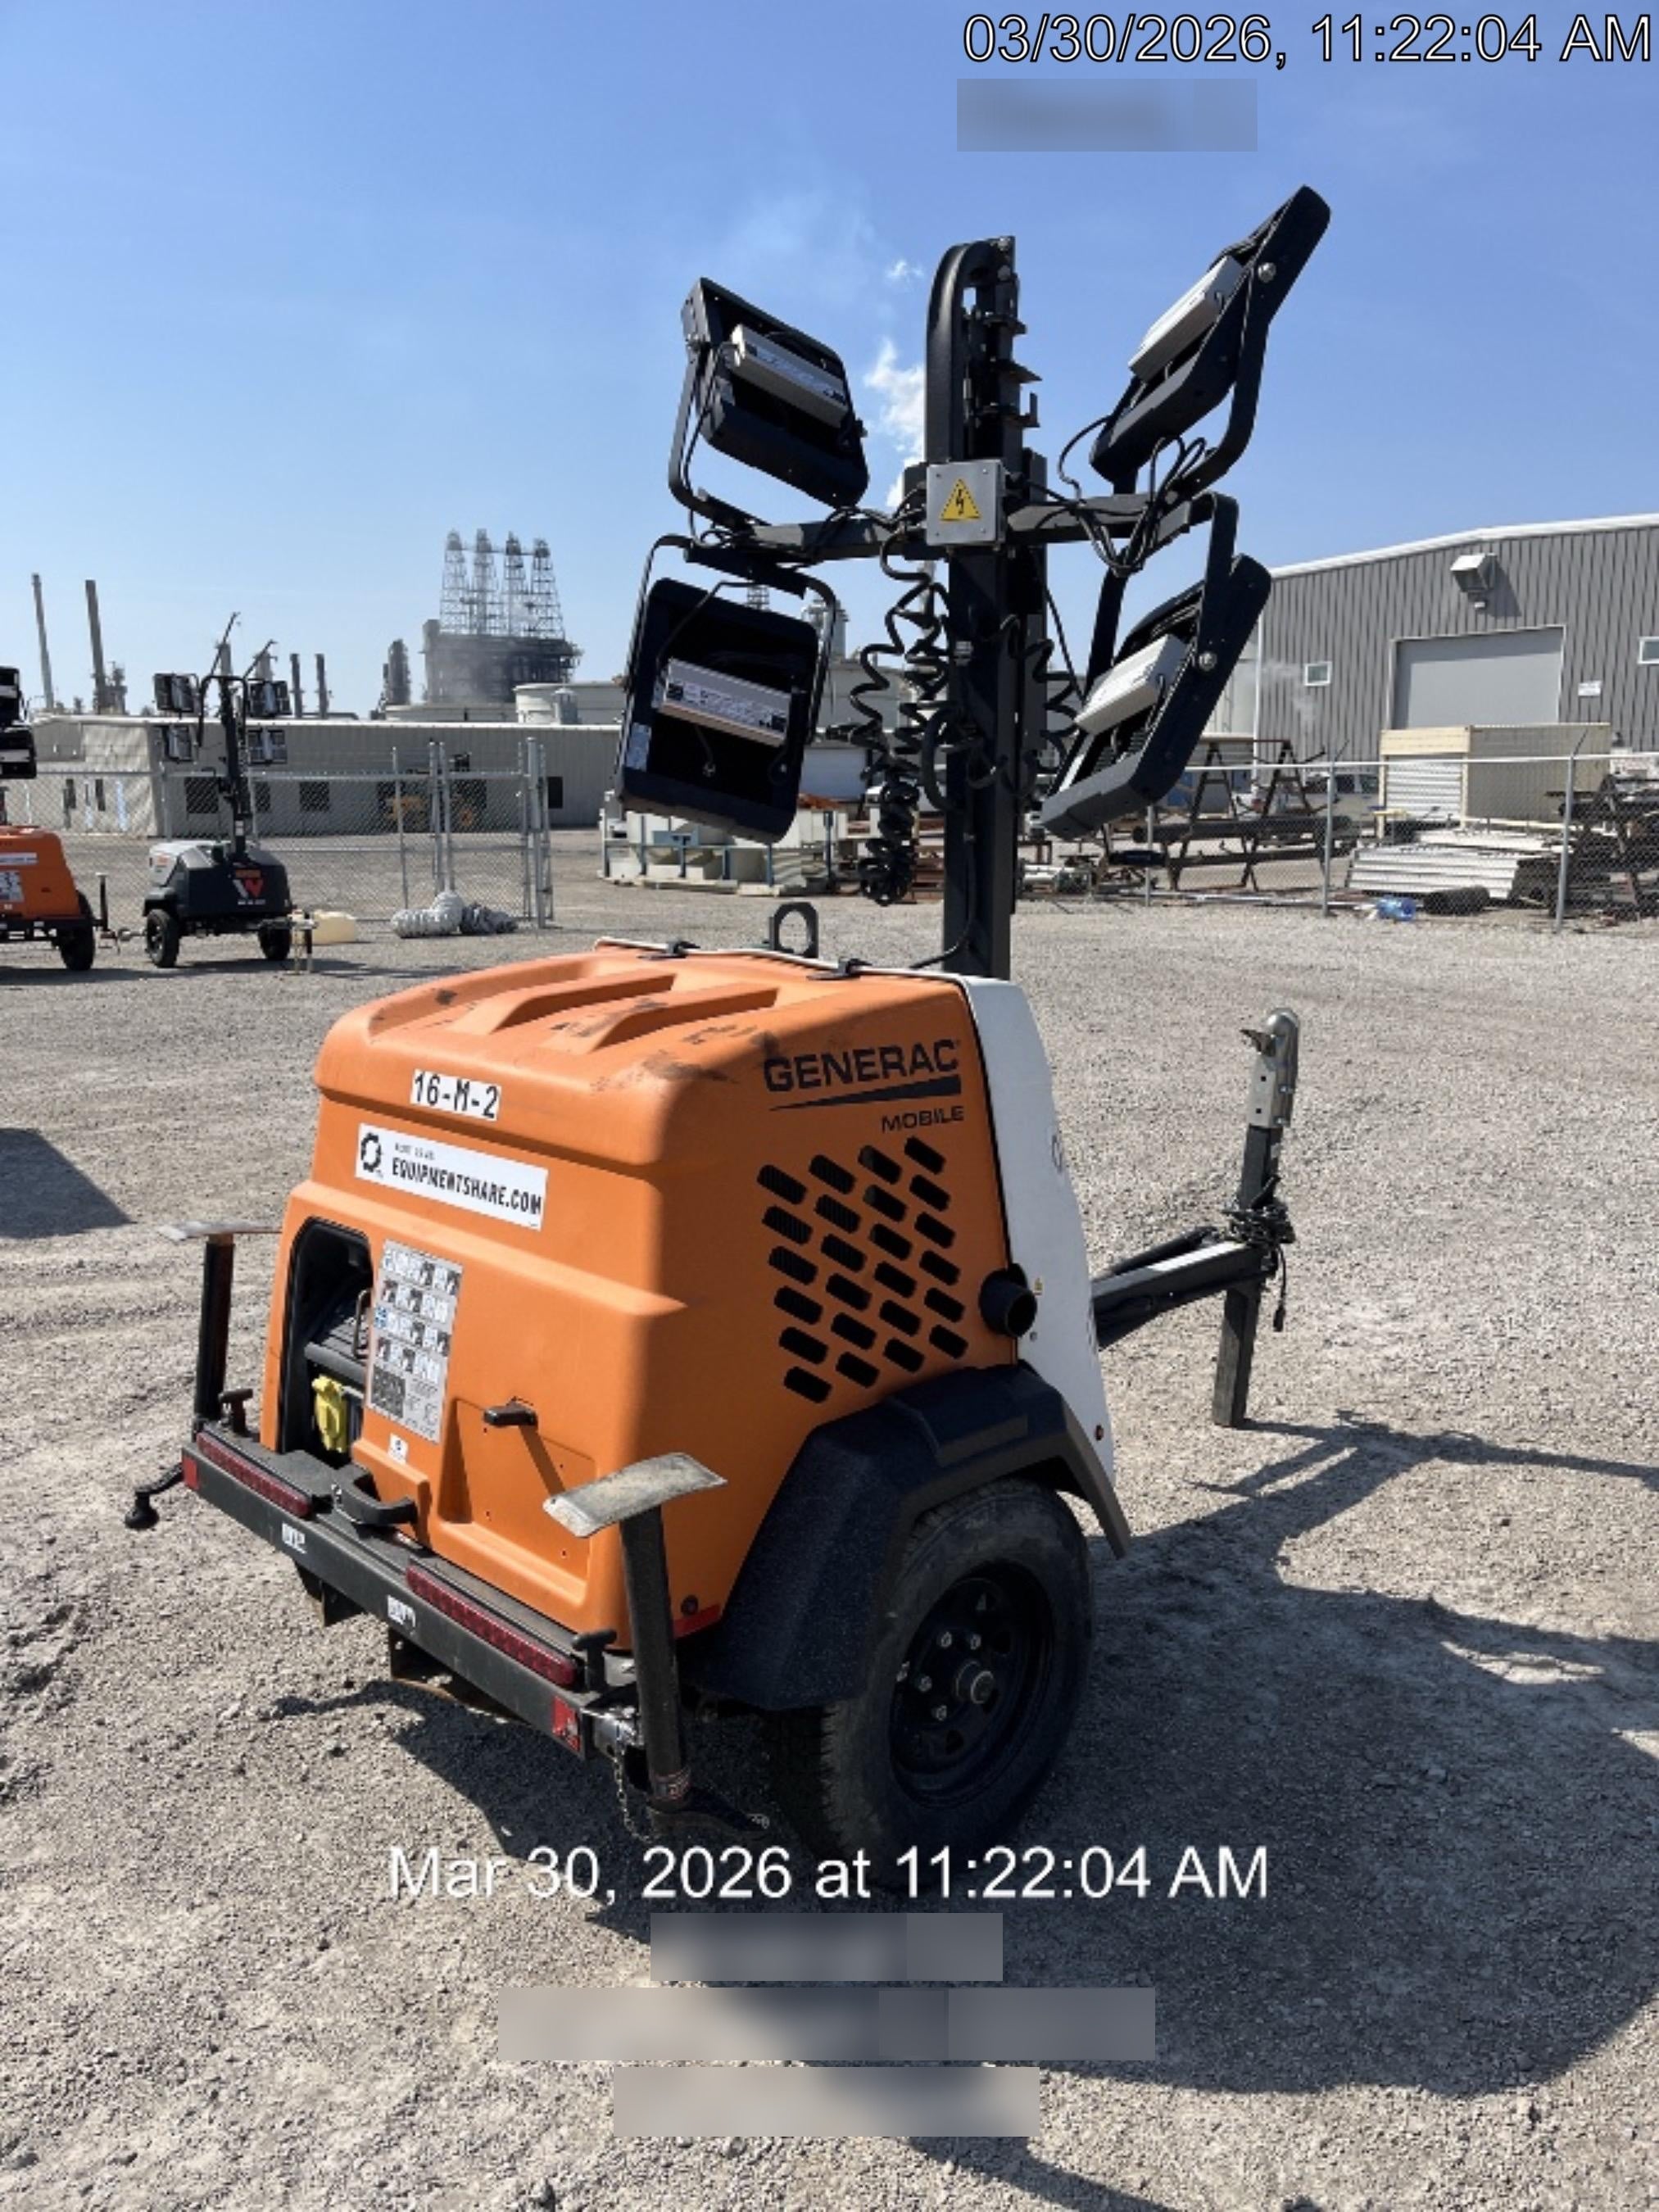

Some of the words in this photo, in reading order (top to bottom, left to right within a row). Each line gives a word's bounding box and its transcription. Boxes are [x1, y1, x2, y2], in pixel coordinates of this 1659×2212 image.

[764, 1039, 959, 1092] GENERAC
[415, 1071, 499, 1119] 16-M-2
[882, 1106, 964, 1134] MOBILE
[392, 1157, 542, 1215] EQUIPMENTSHARE.COM
